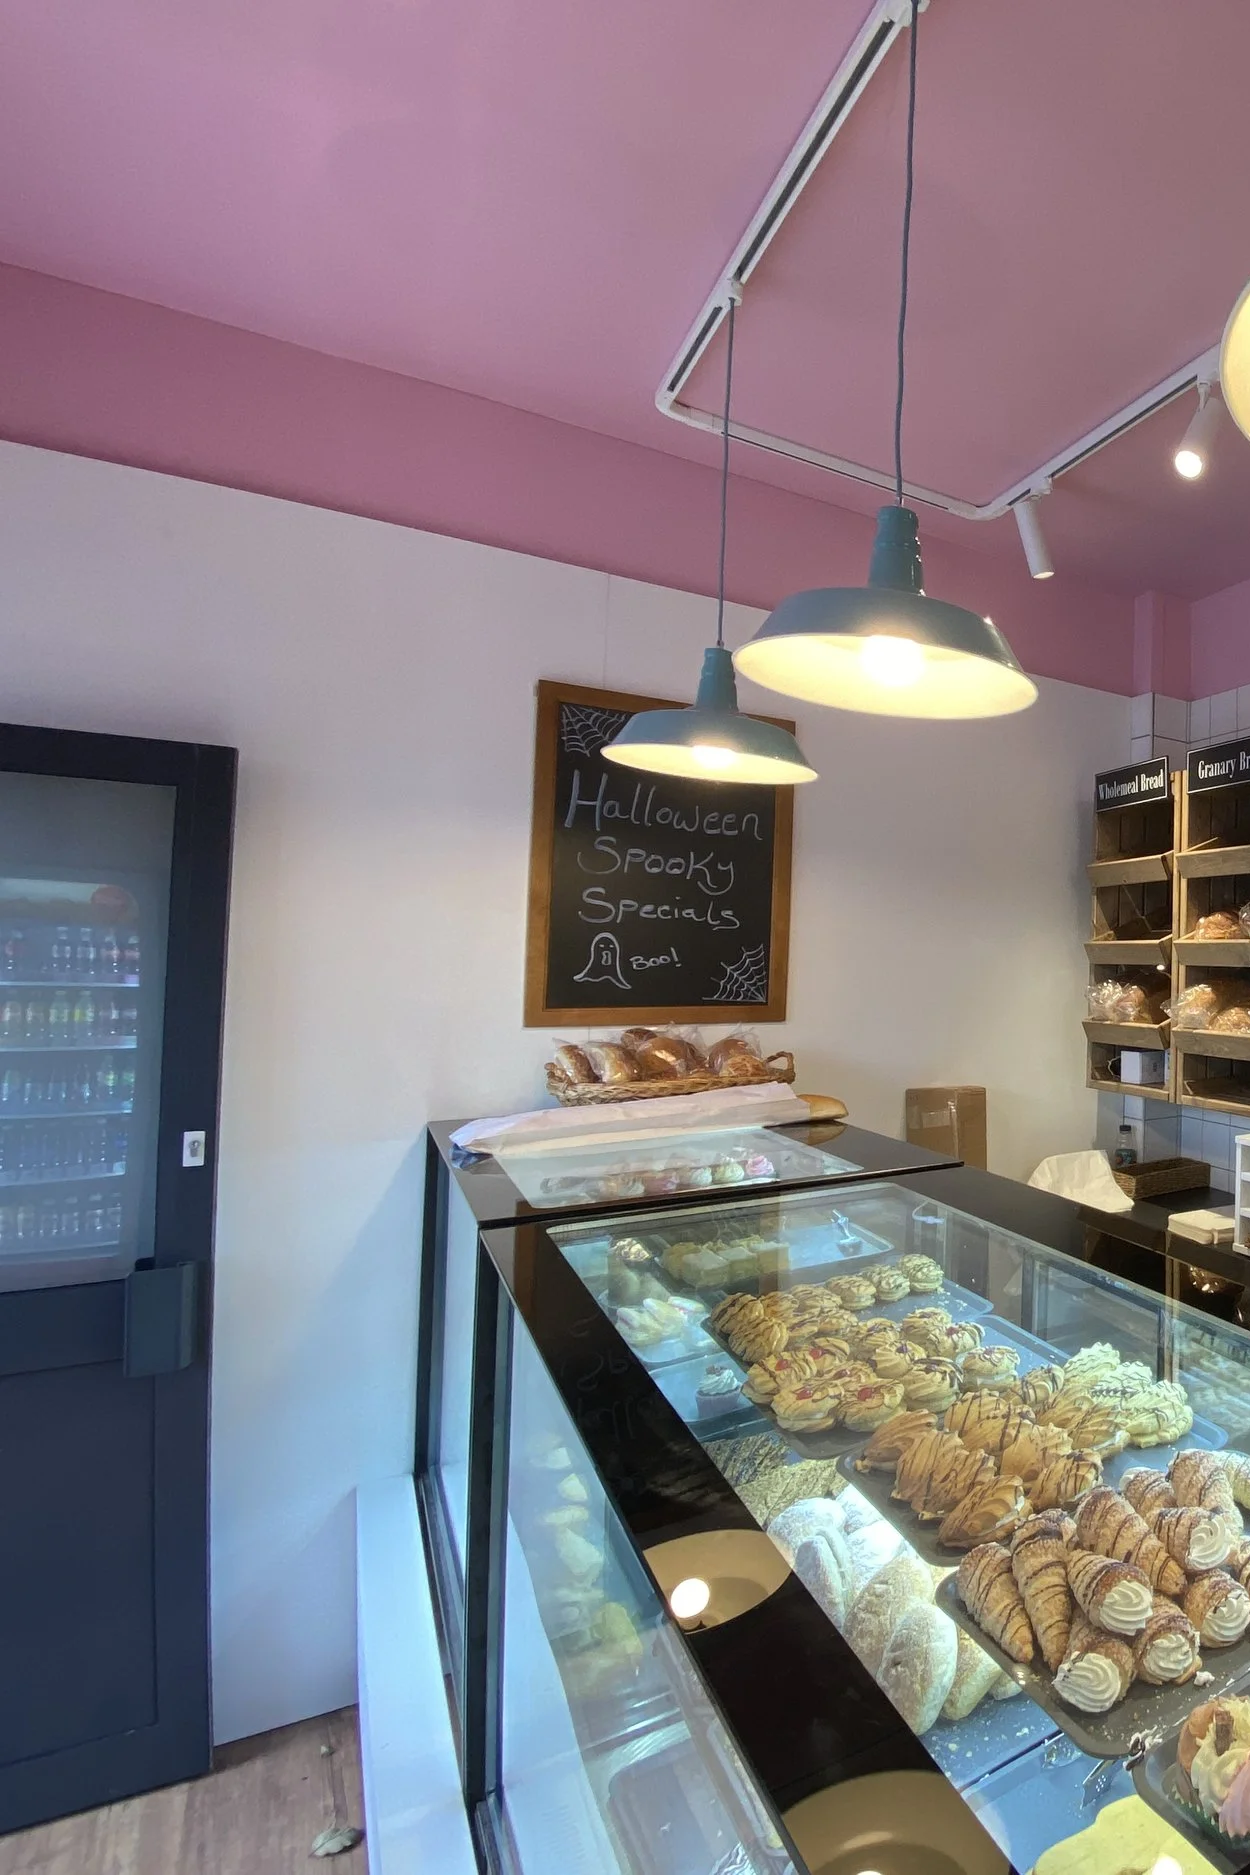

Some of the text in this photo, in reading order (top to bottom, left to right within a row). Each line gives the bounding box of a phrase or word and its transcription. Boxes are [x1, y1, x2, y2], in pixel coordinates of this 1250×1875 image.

[1098, 768, 1164, 800] Wholemeal Bread
[1197, 758, 1238, 780] Granary
[564, 768, 764, 841] Halloween
